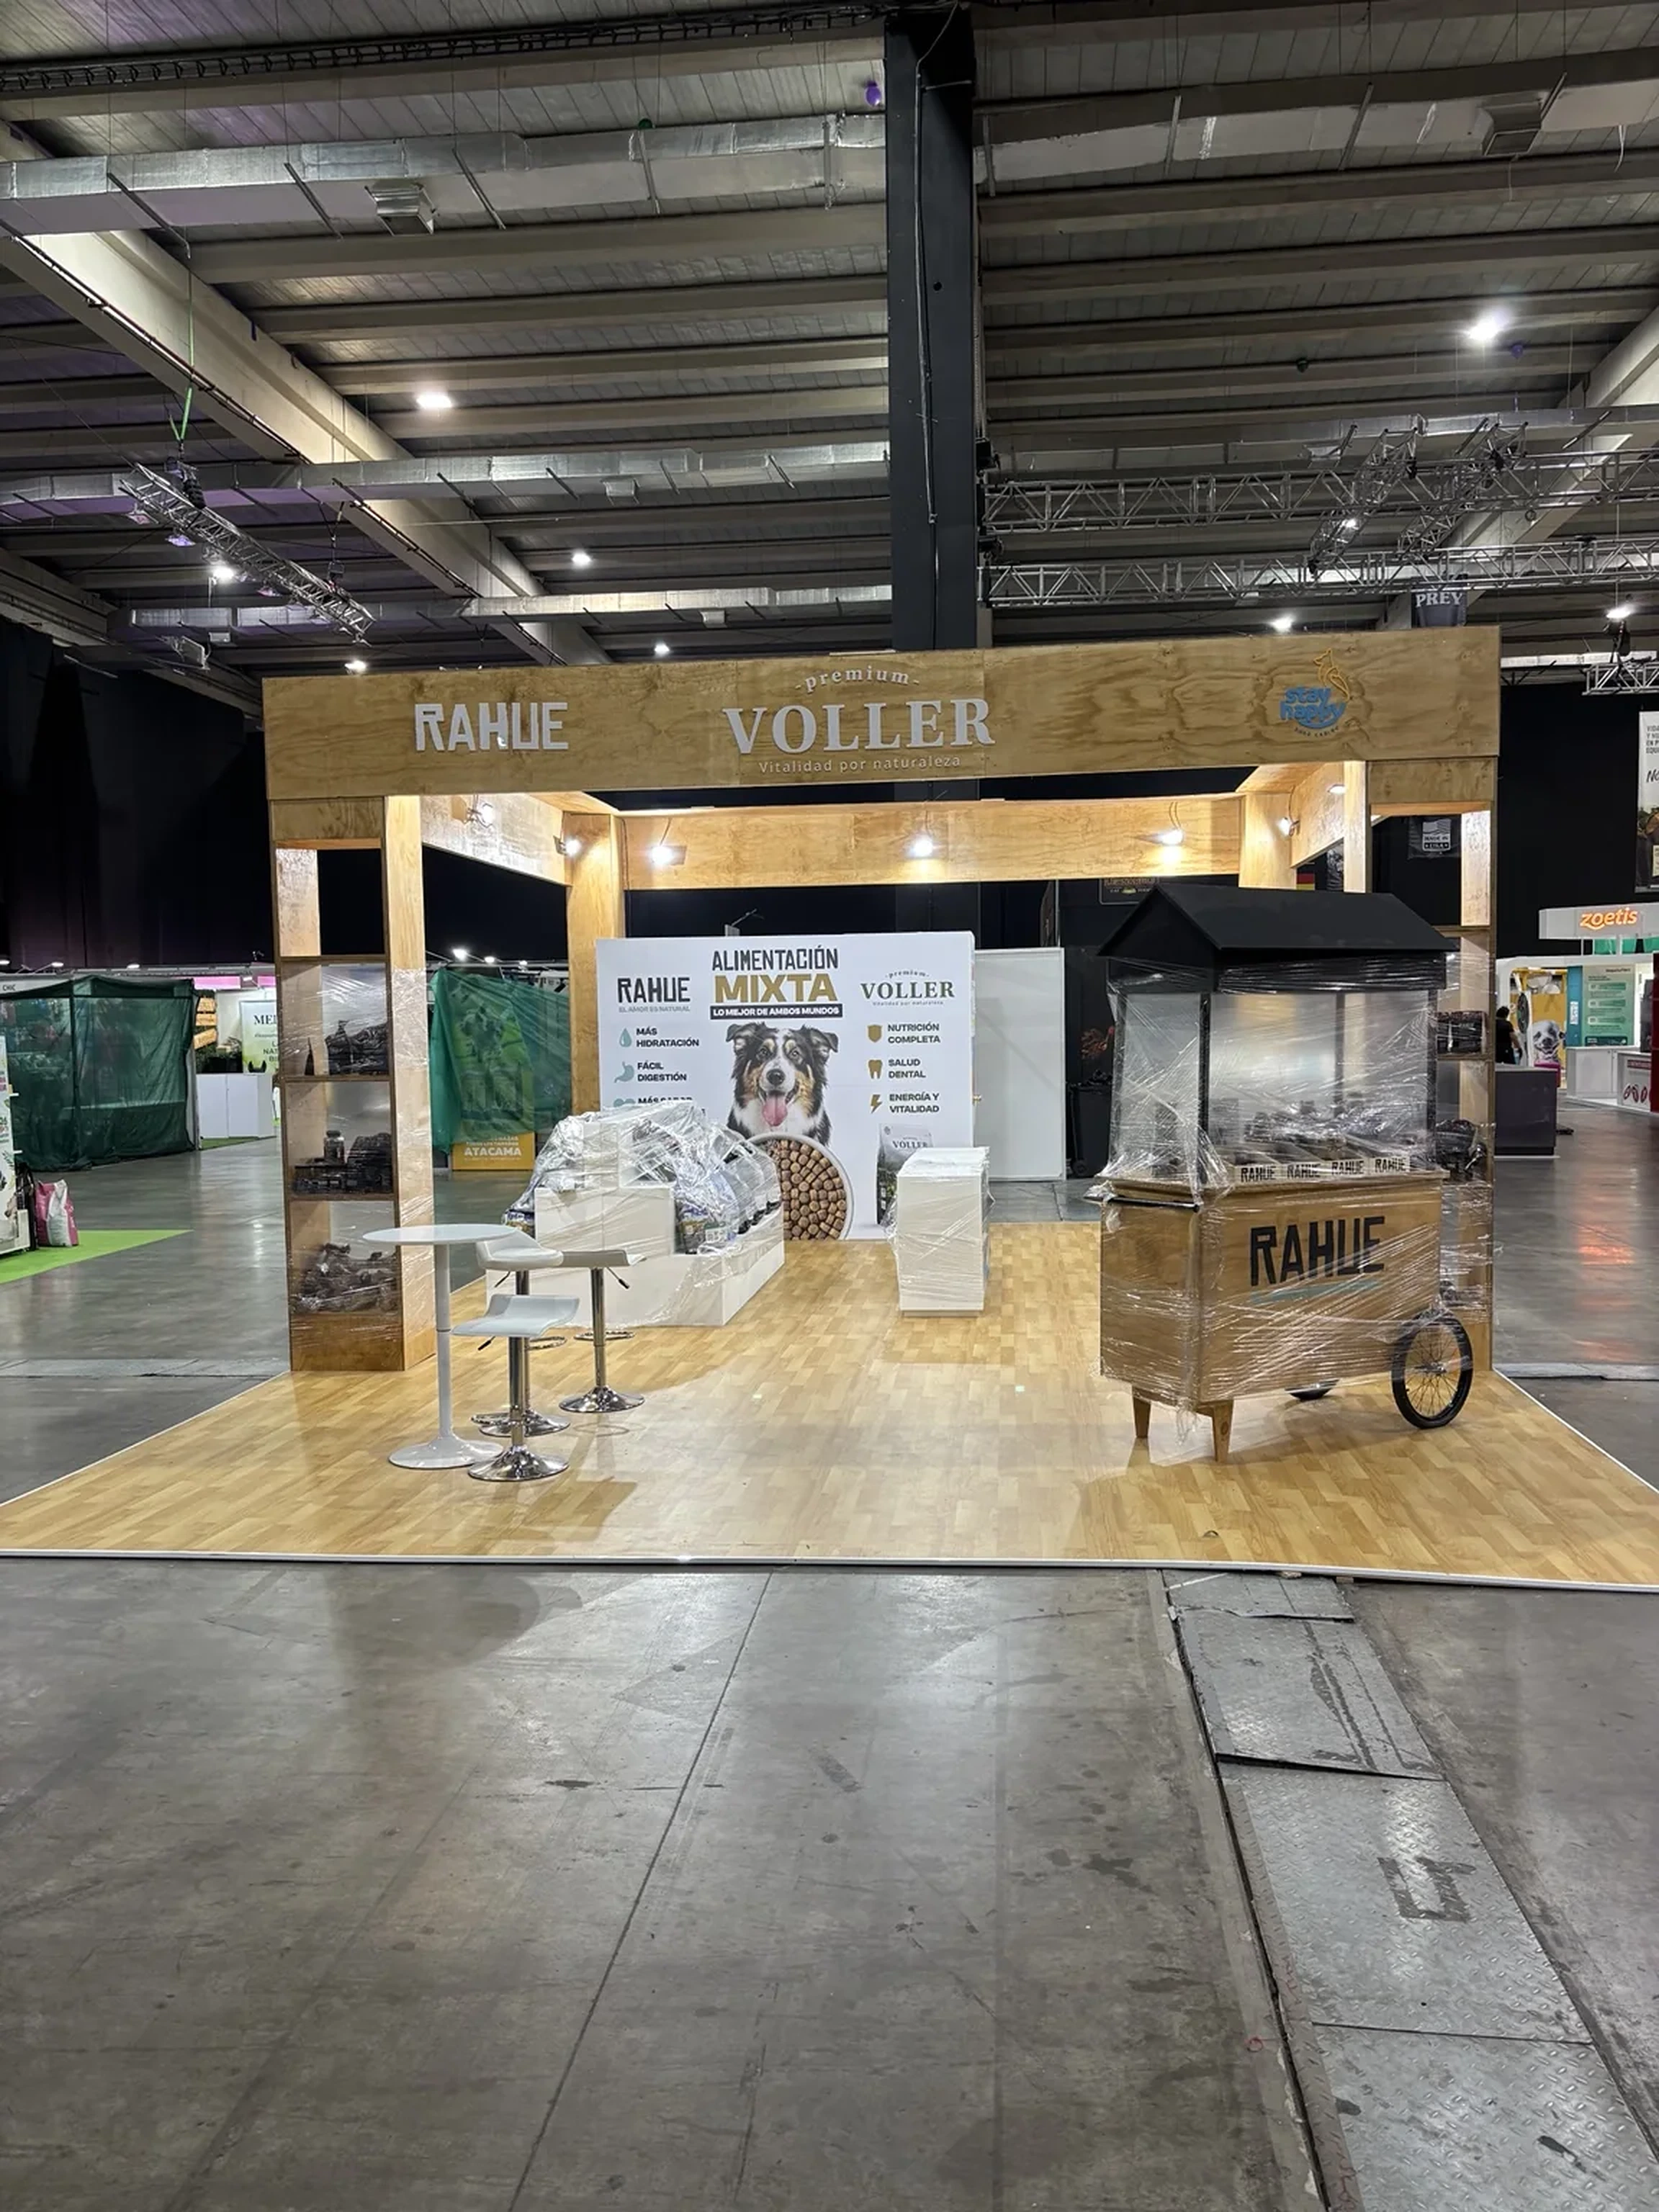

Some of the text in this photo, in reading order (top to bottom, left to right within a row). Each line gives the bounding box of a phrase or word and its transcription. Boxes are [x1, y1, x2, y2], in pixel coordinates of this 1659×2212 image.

[1416, 592, 1463, 608] PREY
[1285, 686, 1331, 706] stay
[1280, 700, 1346, 729] happy
[415, 702, 569, 751] RAHUE
[722, 698, 996, 755] VOLLER
[759, 756, 961, 774] Vitalidad por naturaleza
[1580, 907, 1638, 930] zoetis
[712, 945, 838, 971] ALIMENTACIÓN
[617, 977, 691, 1003] RAHUE
[715, 974, 837, 1003] MIXTA
[860, 981, 955, 999] VOLLER
[801, 1007, 840, 1015] MUNDOS
[636, 1026, 657, 1035] MÁS
[888, 1022, 940, 1031] NUTRICIÓN
[637, 1037, 699, 1047] HIDRATACIÓN
[637, 1060, 664, 1070] FÁCIL
[637, 1071, 687, 1082] DIGESTIÓN
[889, 1092, 931, 1101] ENERGÍA
[464, 1147, 521, 1156] ATACAMA
[1287, 1164, 1321, 1179] RAHUE
[1332, 1160, 1364, 1174] RAHUE
[1375, 1158, 1407, 1173] RAHUE
[1241, 1166, 1276, 1182] RAHUE
[1251, 1216, 1385, 1287] RAHUE
